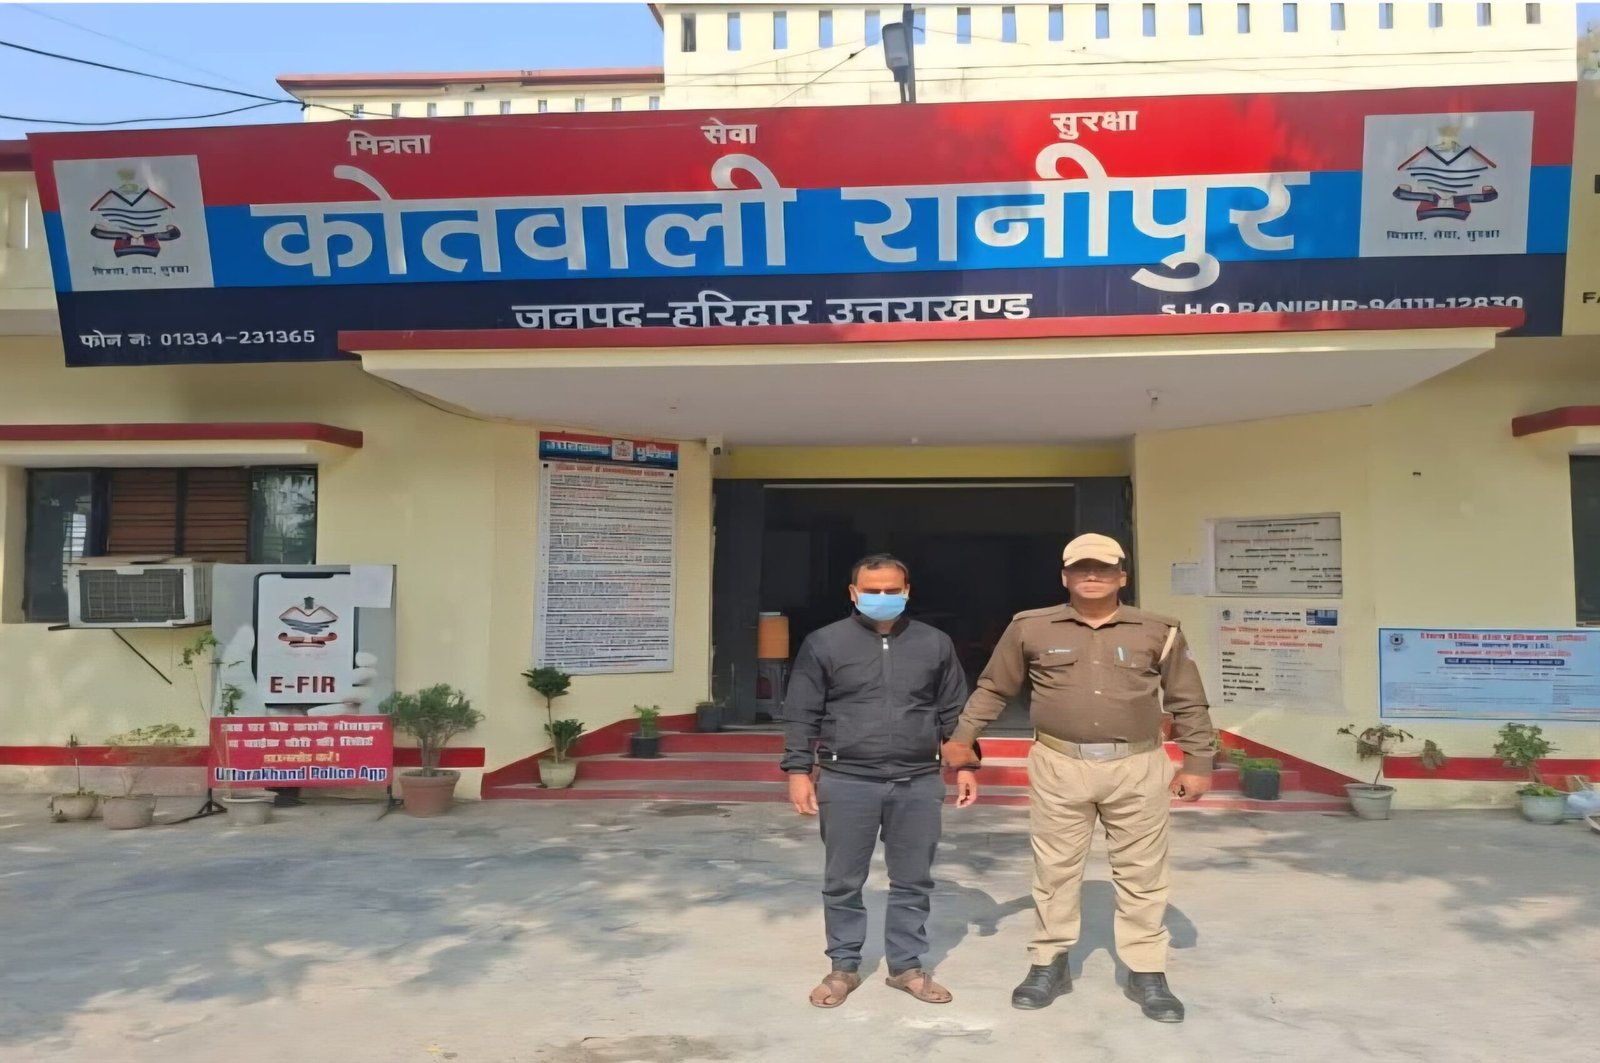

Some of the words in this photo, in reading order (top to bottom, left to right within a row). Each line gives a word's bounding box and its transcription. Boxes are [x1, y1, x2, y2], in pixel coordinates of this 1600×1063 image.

[700, 117, 758, 145] सेवा
[1050, 110, 1138, 140] सुरक्षा
[347, 130, 431, 156] मित्रता
[249, 153, 797, 277] कोतवाली
[840, 142, 1311, 292] रानीपुर
[511, 289, 813, 330] जनपद-हरिद्वार
[825, 293, 1033, 324] उत्तराखण्ड
[79, 329, 122, 348] फोन
[160, 329, 316, 346] 01334-231365
[269, 675, 336, 694] E-FIR
